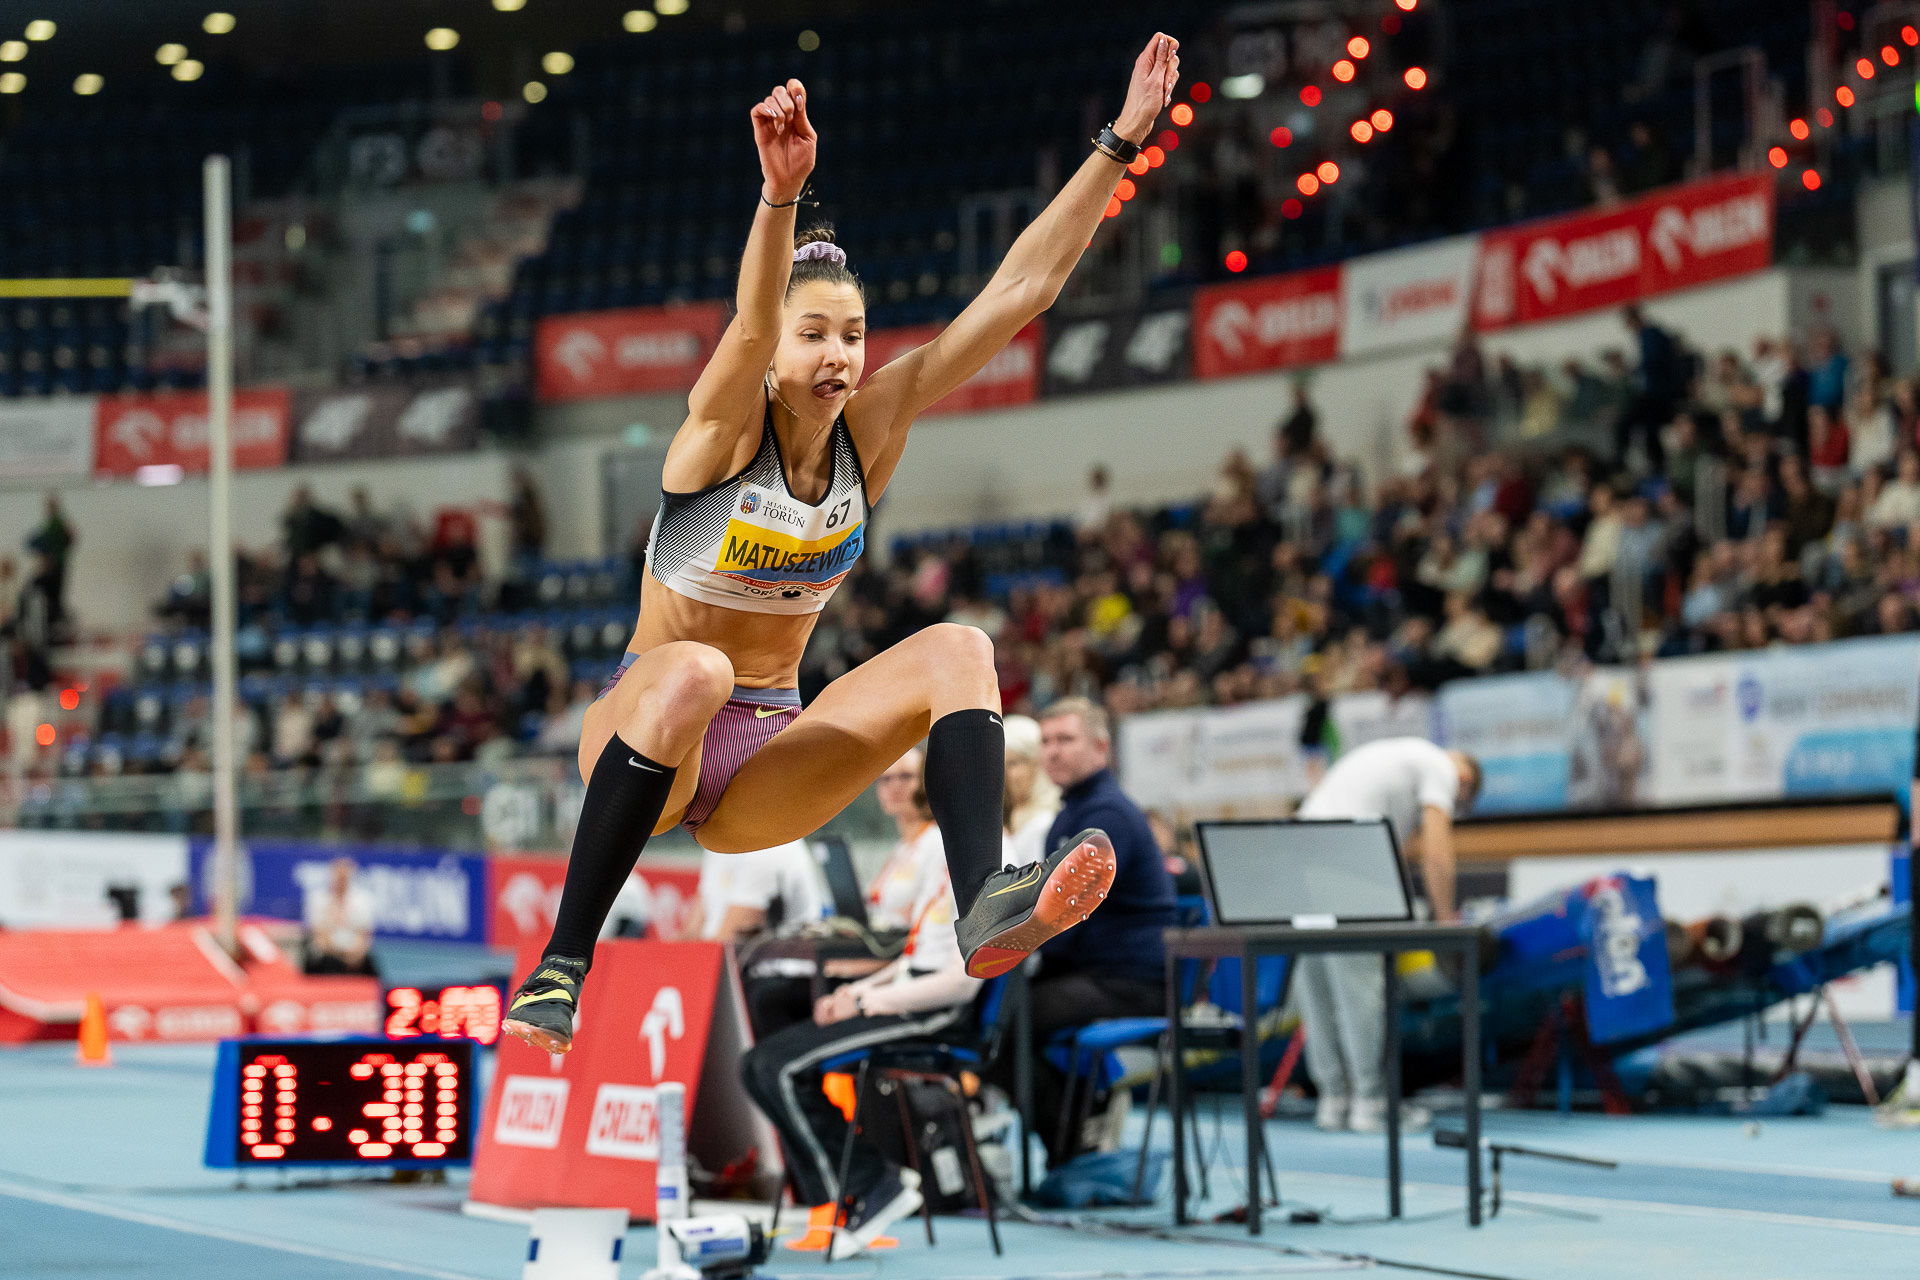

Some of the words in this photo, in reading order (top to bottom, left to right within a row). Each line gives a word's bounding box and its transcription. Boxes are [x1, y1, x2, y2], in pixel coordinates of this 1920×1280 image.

[762, 505, 806, 529] TORUŃ
[766, 500, 799, 515] MIASTO
[825, 498, 851, 529] 67
[724, 535, 860, 574] MATUSZEWICZ
